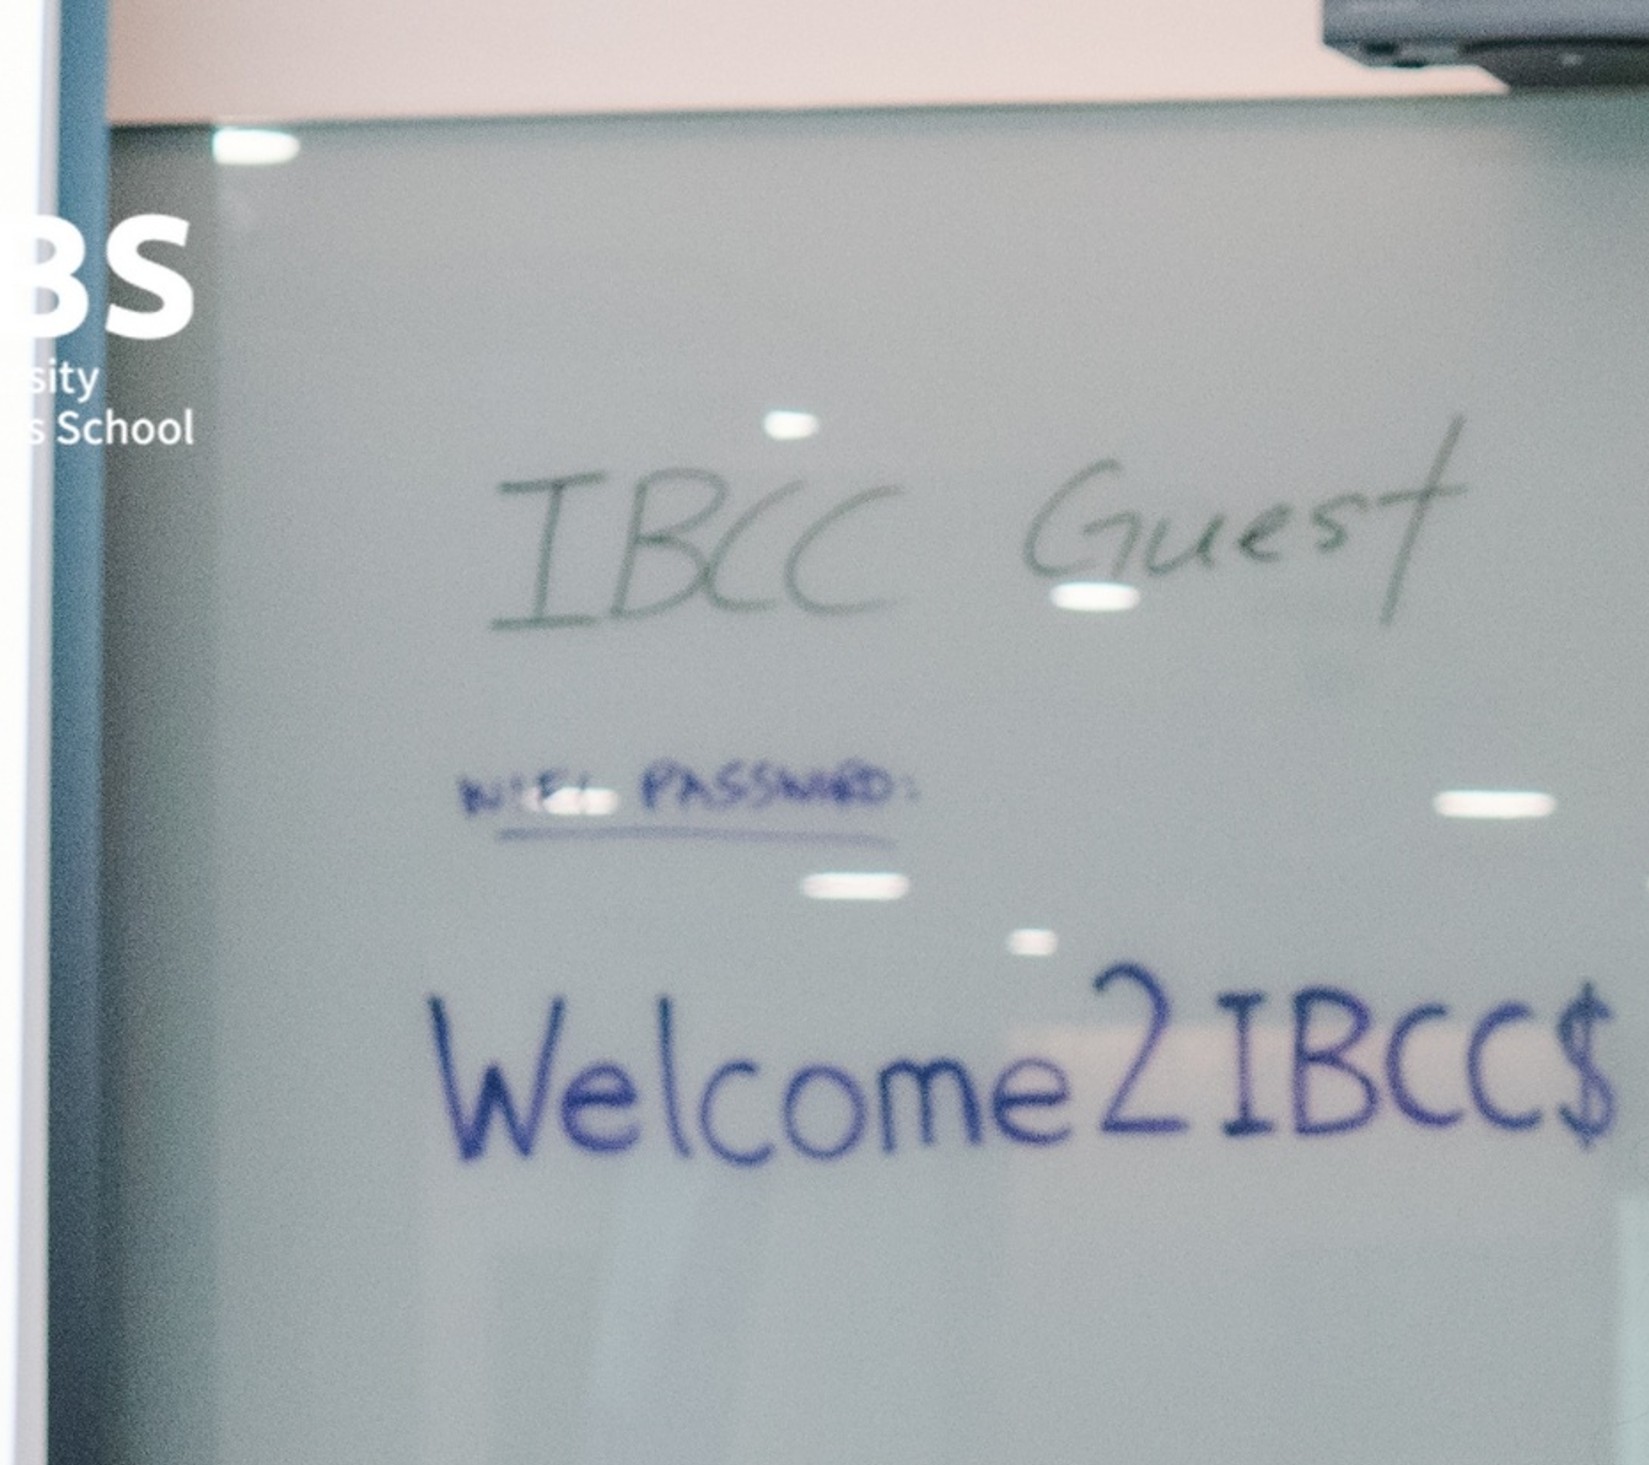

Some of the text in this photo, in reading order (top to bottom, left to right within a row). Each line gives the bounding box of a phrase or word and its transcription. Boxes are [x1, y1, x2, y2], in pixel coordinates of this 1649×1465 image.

[488, 413, 1472, 632] IBCC Guest
[428, 961, 1618, 1167] Welcome2IBCC$
